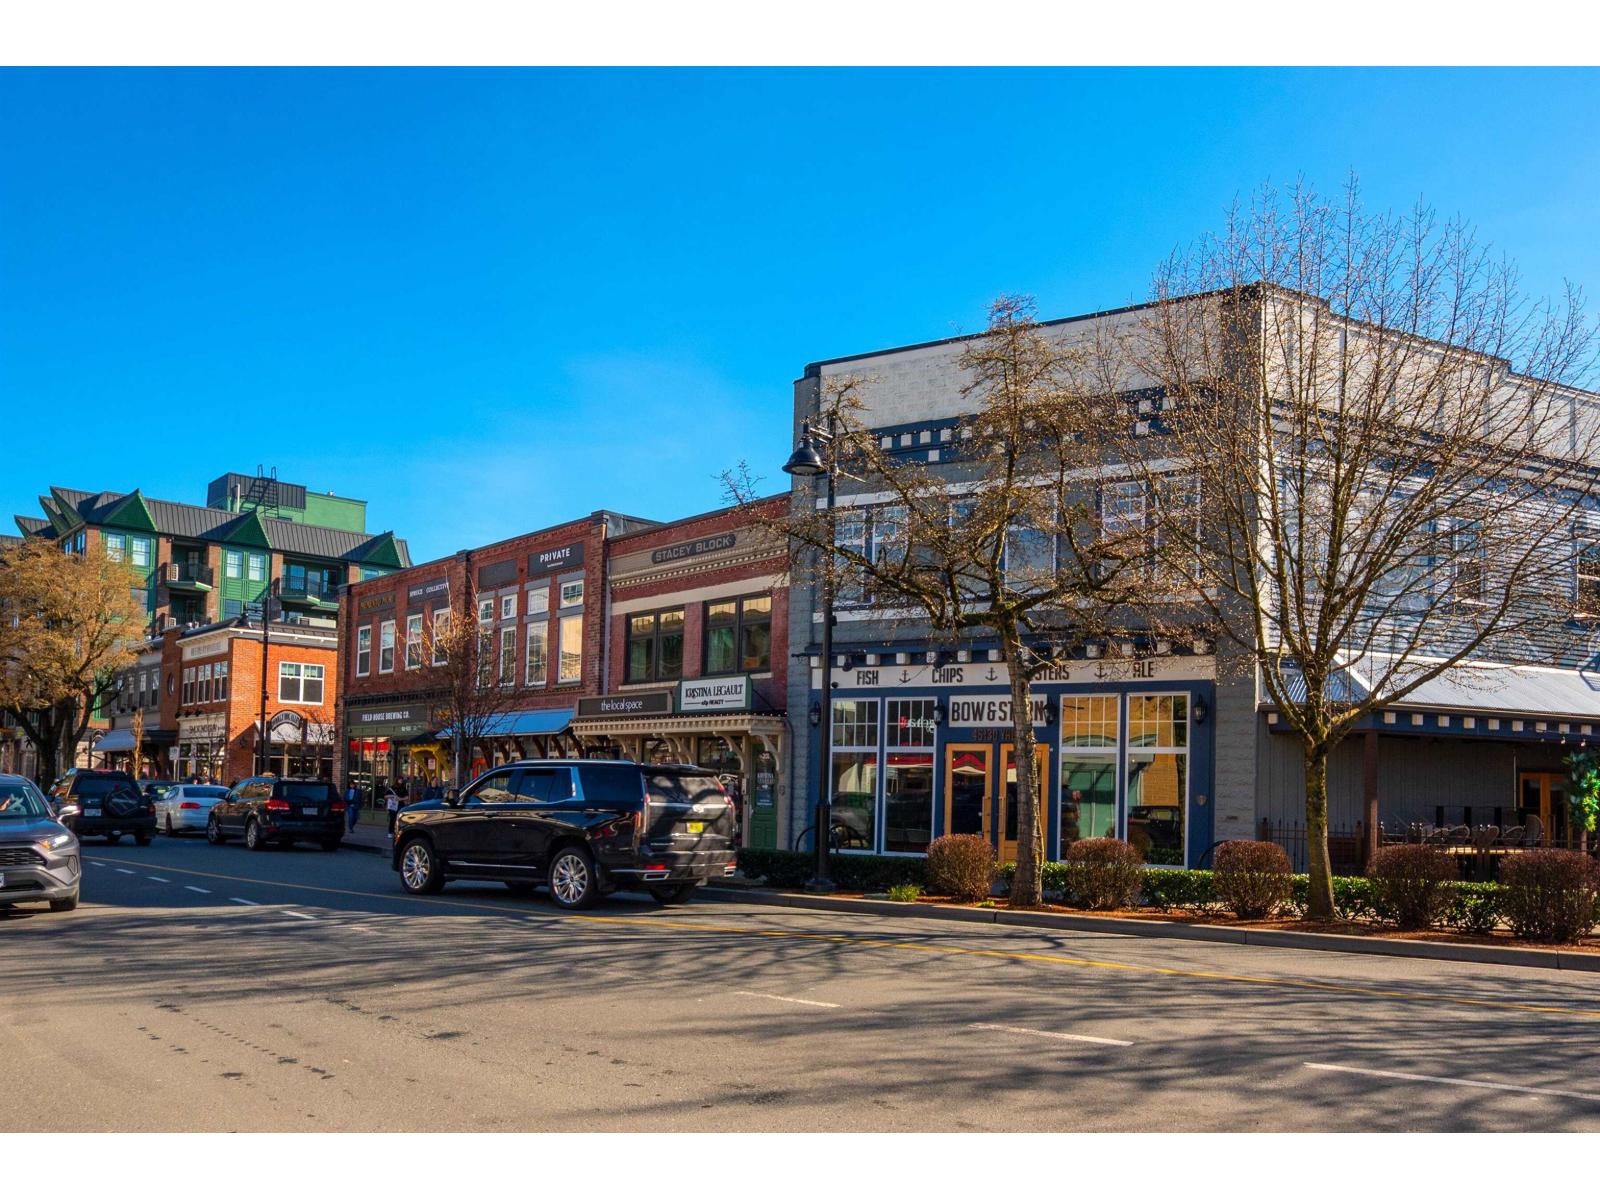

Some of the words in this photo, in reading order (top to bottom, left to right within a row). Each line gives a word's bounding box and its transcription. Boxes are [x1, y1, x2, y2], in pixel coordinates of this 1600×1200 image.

[540, 547, 571, 563] PRIVATE
[655, 545, 692, 561] STACEY
[696, 536, 730, 552] BLOCK
[856, 669, 879, 685] FISH
[931, 667, 963, 684] CHIPS
[1035, 664, 1070, 681] STERS
[1132, 661, 1154, 678] ALE
[713, 684, 743, 696] LEGAULT
[625, 700, 643, 712] space
[362, 713, 372, 722] FIELD
